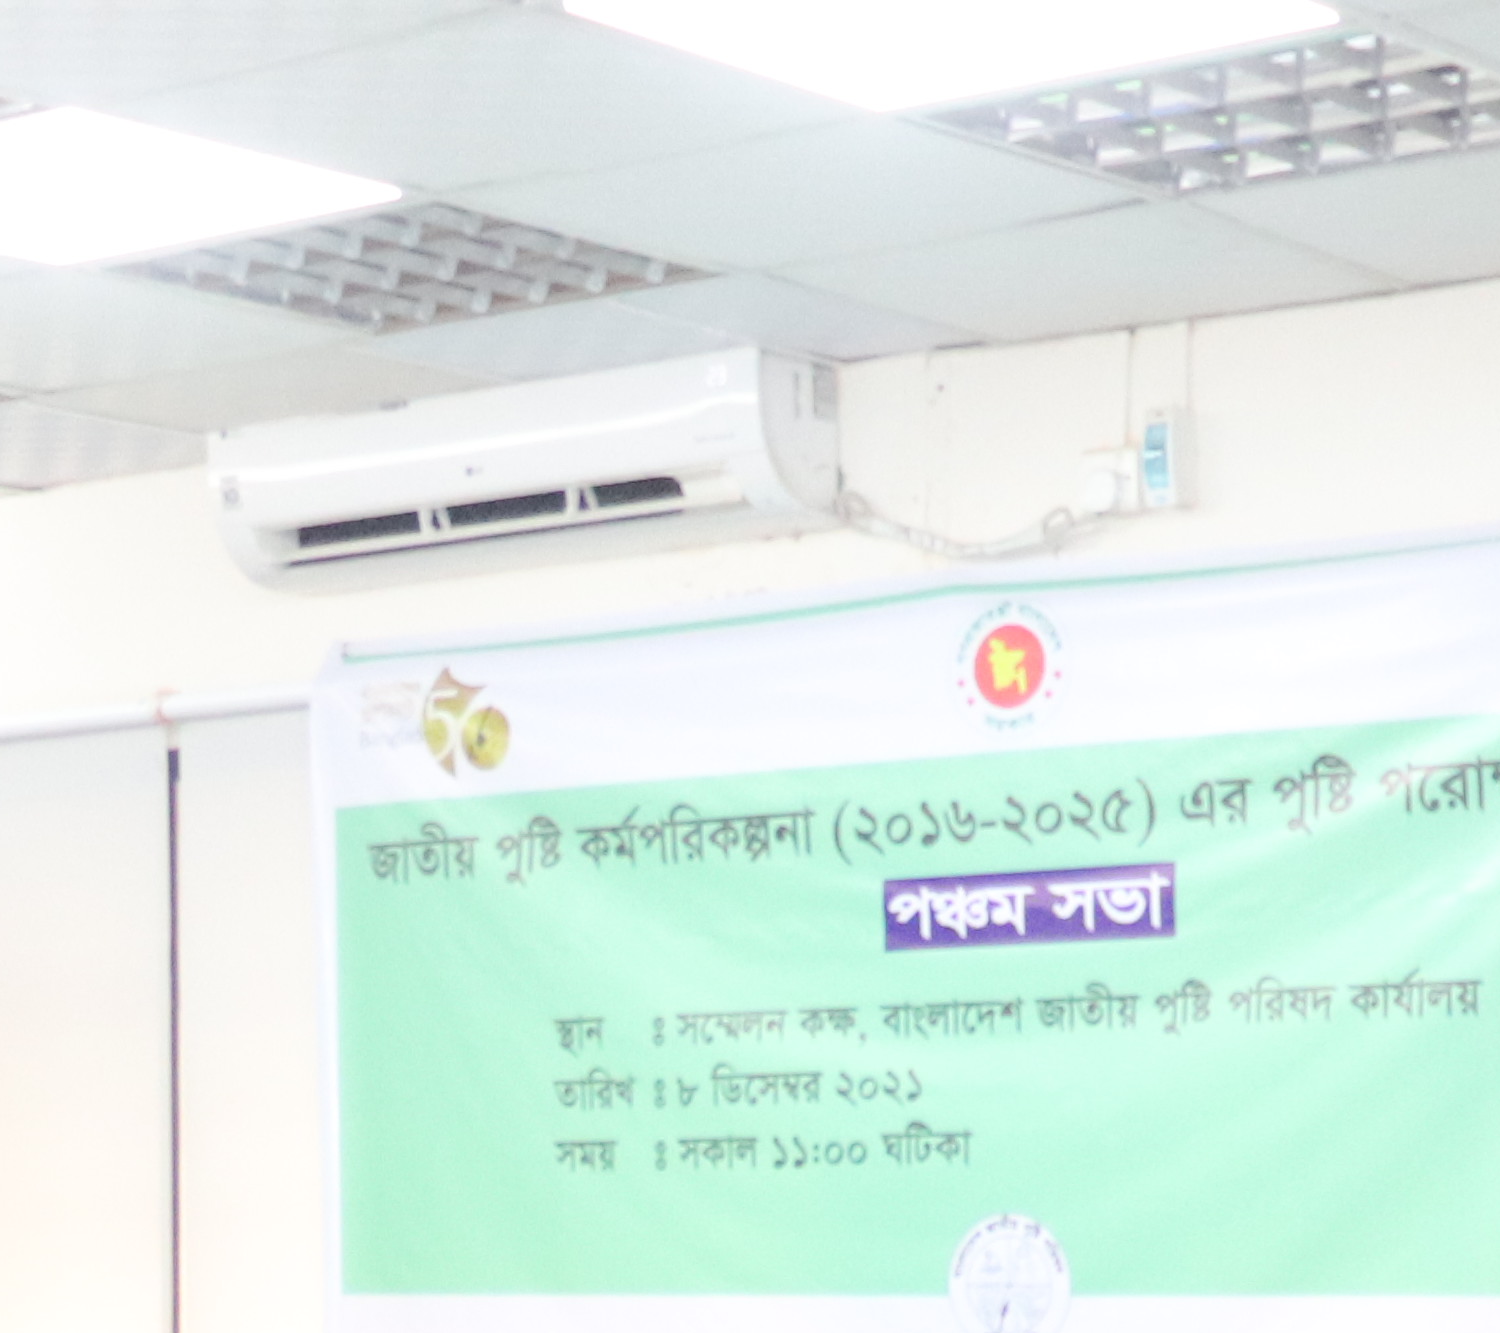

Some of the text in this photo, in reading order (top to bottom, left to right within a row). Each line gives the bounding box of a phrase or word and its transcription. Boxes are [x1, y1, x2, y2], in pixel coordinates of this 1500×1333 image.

[368, 821, 479, 885] জাতীয়
[496, 815, 562, 887] পুষ্টি
[576, 803, 815, 867] কর্মপরিকল্পনা
[834, 776, 1157, 866] (২০১৬-২০২৫)
[1181, 777, 1252, 825] এর
[1273, 753, 1356, 834] পুষ্টি
[886, 871, 1171, 941] পঞ্চম সভা
[554, 1016, 604, 1055] স্থান
[879, 997, 1023, 1038] বাংলাদেশ
[1036, 981, 1139, 1033] জাতীয়
[1154, 978, 1213, 1034] পুষ্টি
[1228, 975, 1336, 1024] পরিষদ
[1347, 967, 1483, 1019] কার্যালয়
[554, 1067, 635, 1111] তারিখ
[711, 1062, 823, 1108] ডিসেম্বর
[834, 1069, 924, 1107] ২০২১
[554, 1140, 617, 1172] সময়
[677, 1137, 758, 1170] সকাল
[882, 1121, 973, 1167] ঘটিকা
